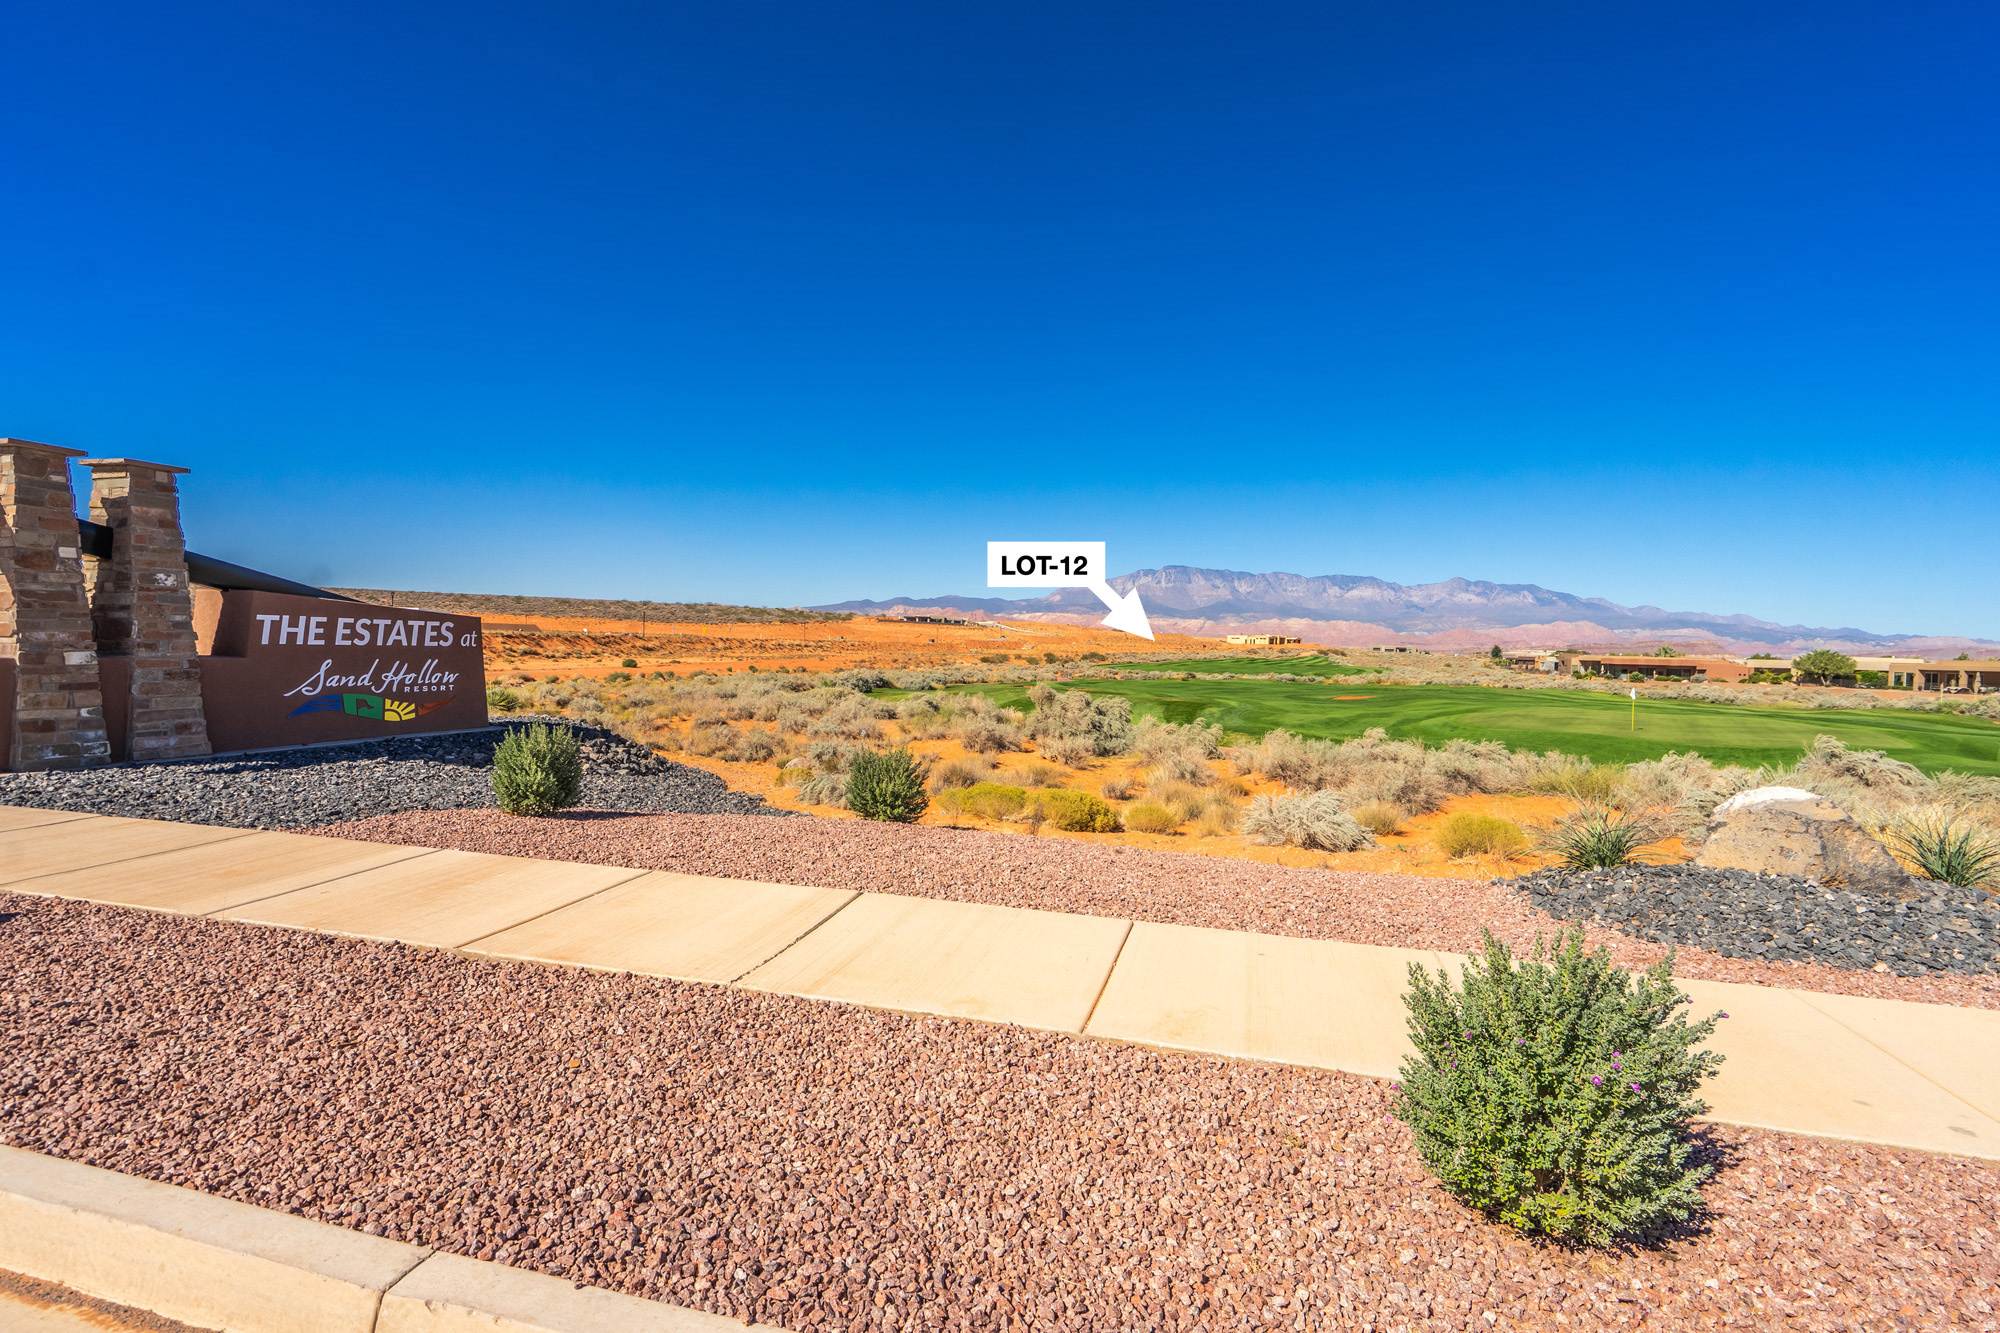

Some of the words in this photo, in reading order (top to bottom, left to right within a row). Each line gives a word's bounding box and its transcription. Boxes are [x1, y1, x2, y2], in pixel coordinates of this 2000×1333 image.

[256, 614, 328, 645] THE
[335, 617, 455, 647] ESTATES
[460, 630, 477, 647] at
[283, 659, 379, 696] Sand
[371, 659, 459, 693] Hollow
[404, 684, 455, 693] RESORT
